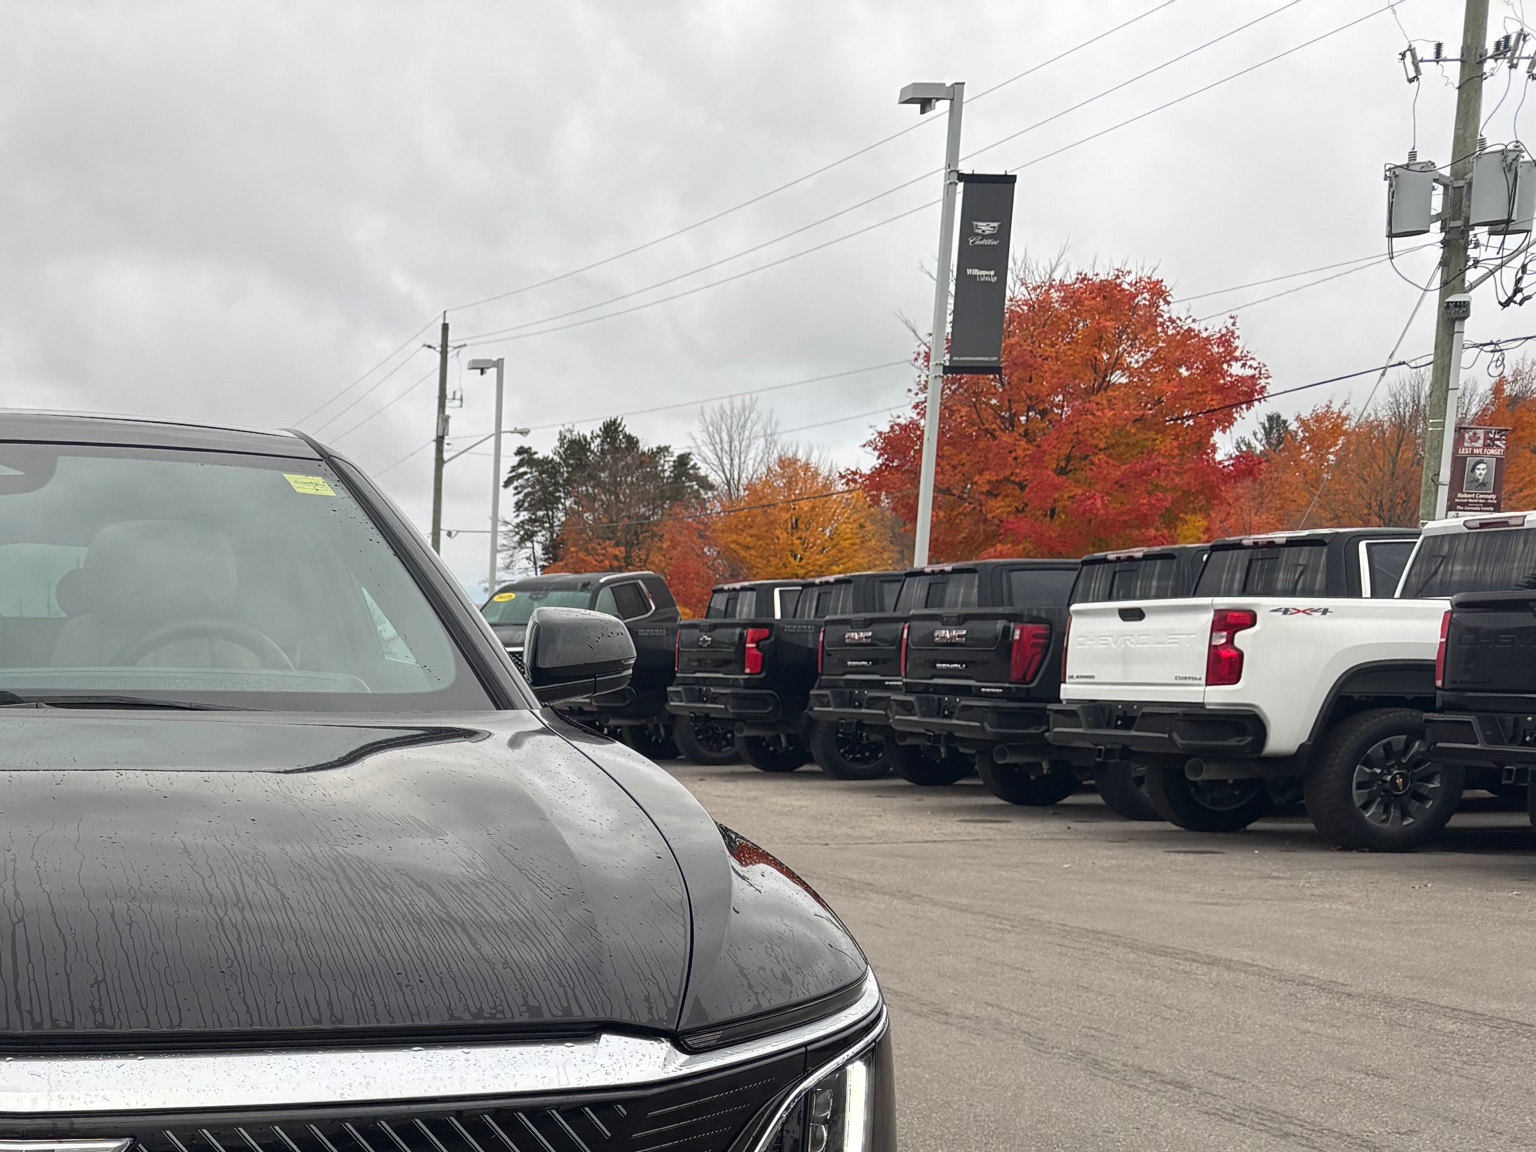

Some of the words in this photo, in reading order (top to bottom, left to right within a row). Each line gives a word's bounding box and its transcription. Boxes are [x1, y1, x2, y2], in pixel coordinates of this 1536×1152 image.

[968, 236, 1000, 246] Cadillac
[844, 632, 873, 643] GMC
[934, 629, 967, 643] GMC
[1075, 632, 1197, 649] CHEVROLET
